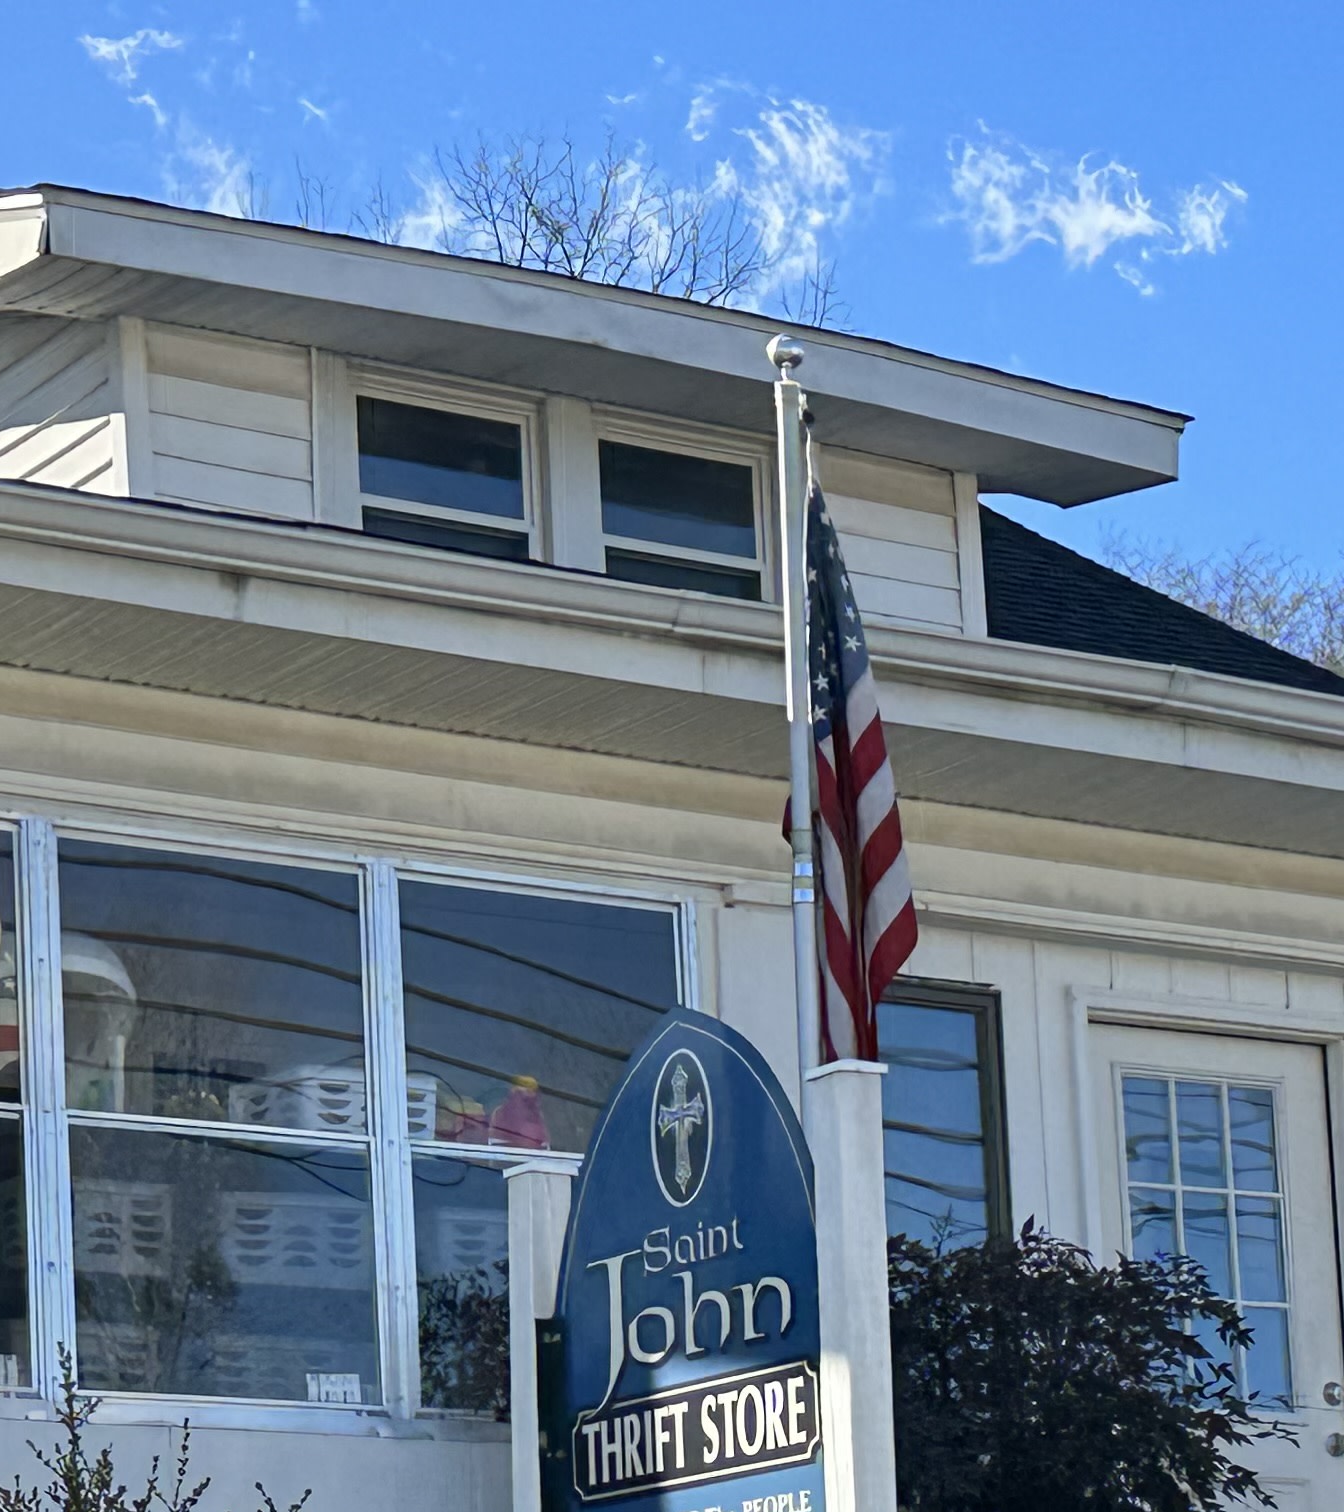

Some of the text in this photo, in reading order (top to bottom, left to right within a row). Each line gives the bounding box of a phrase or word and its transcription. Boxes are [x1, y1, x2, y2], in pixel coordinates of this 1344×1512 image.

[642, 1216, 744, 1275] Saint
[586, 1249, 792, 1419] John
[582, 1376, 807, 1486] THRIFT STORE
